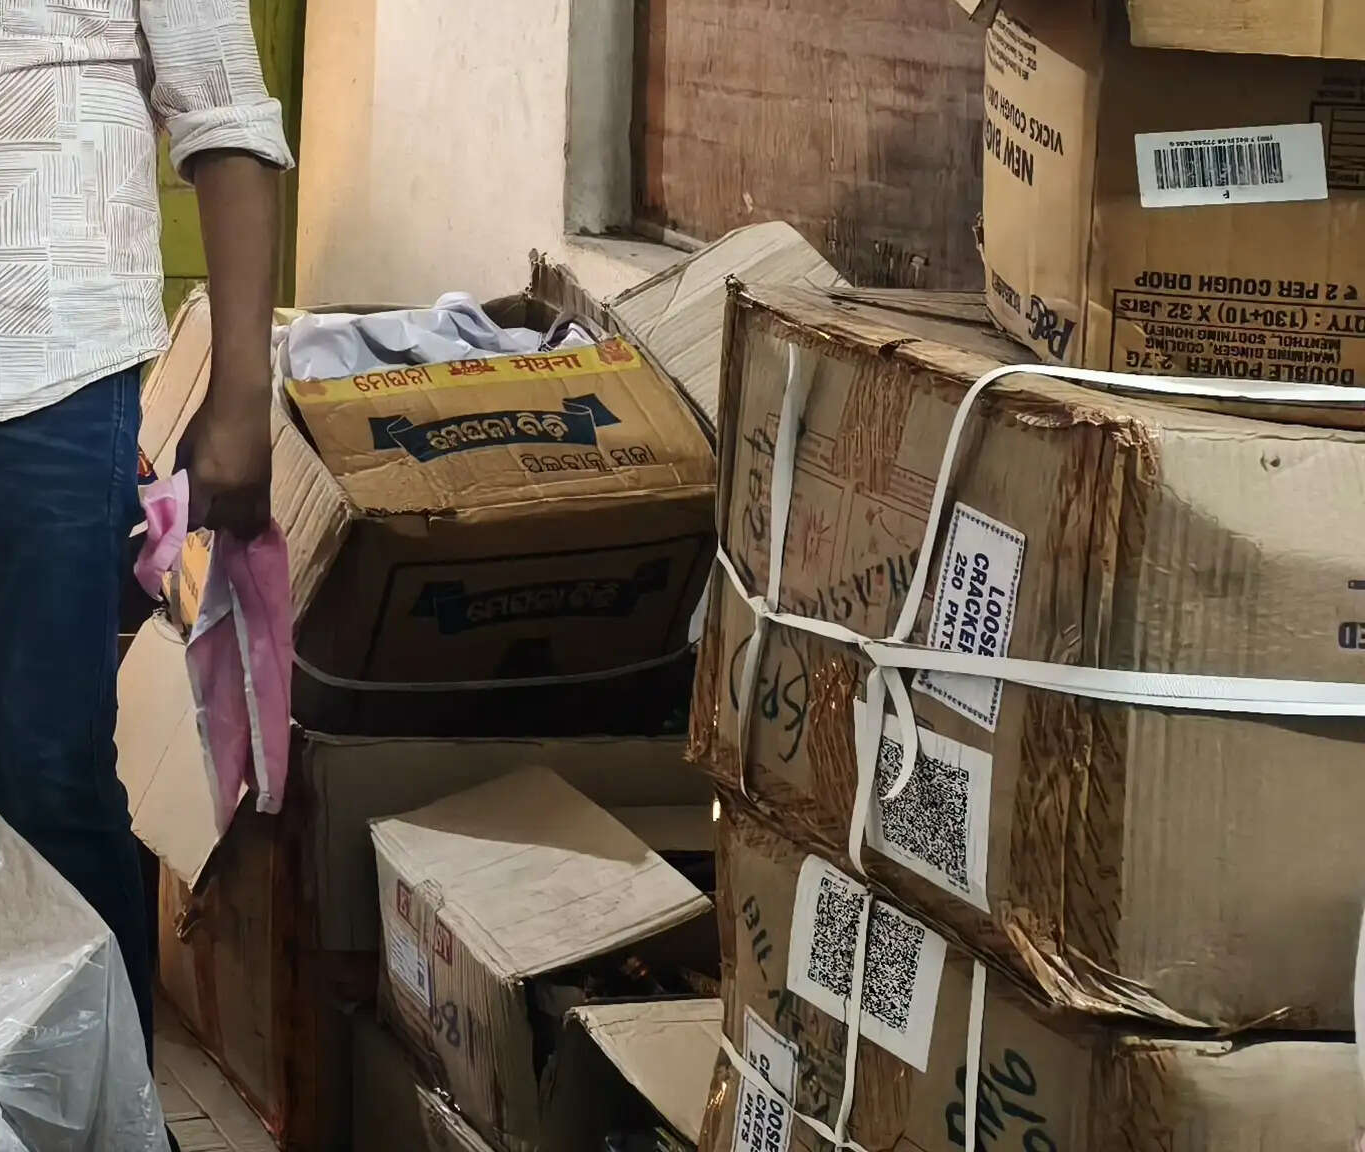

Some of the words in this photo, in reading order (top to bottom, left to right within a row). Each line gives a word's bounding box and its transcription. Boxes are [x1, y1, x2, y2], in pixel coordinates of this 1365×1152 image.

[1002, 146, 1035, 186] NEW
[1134, 271, 1192, 291] DROP
[1198, 274, 1272, 297] COUGH
[1276, 280, 1319, 300] PER
[1326, 284, 1339, 300] 2
[1167, 302, 1193, 320] 32
[1026, 293, 1077, 360] P&G
[1186, 356, 1263, 378] POWER
[1268, 364, 1355, 385] DOUBLE
[951, 553, 968, 590] 250
[960, 551, 990, 656] CRACKER
